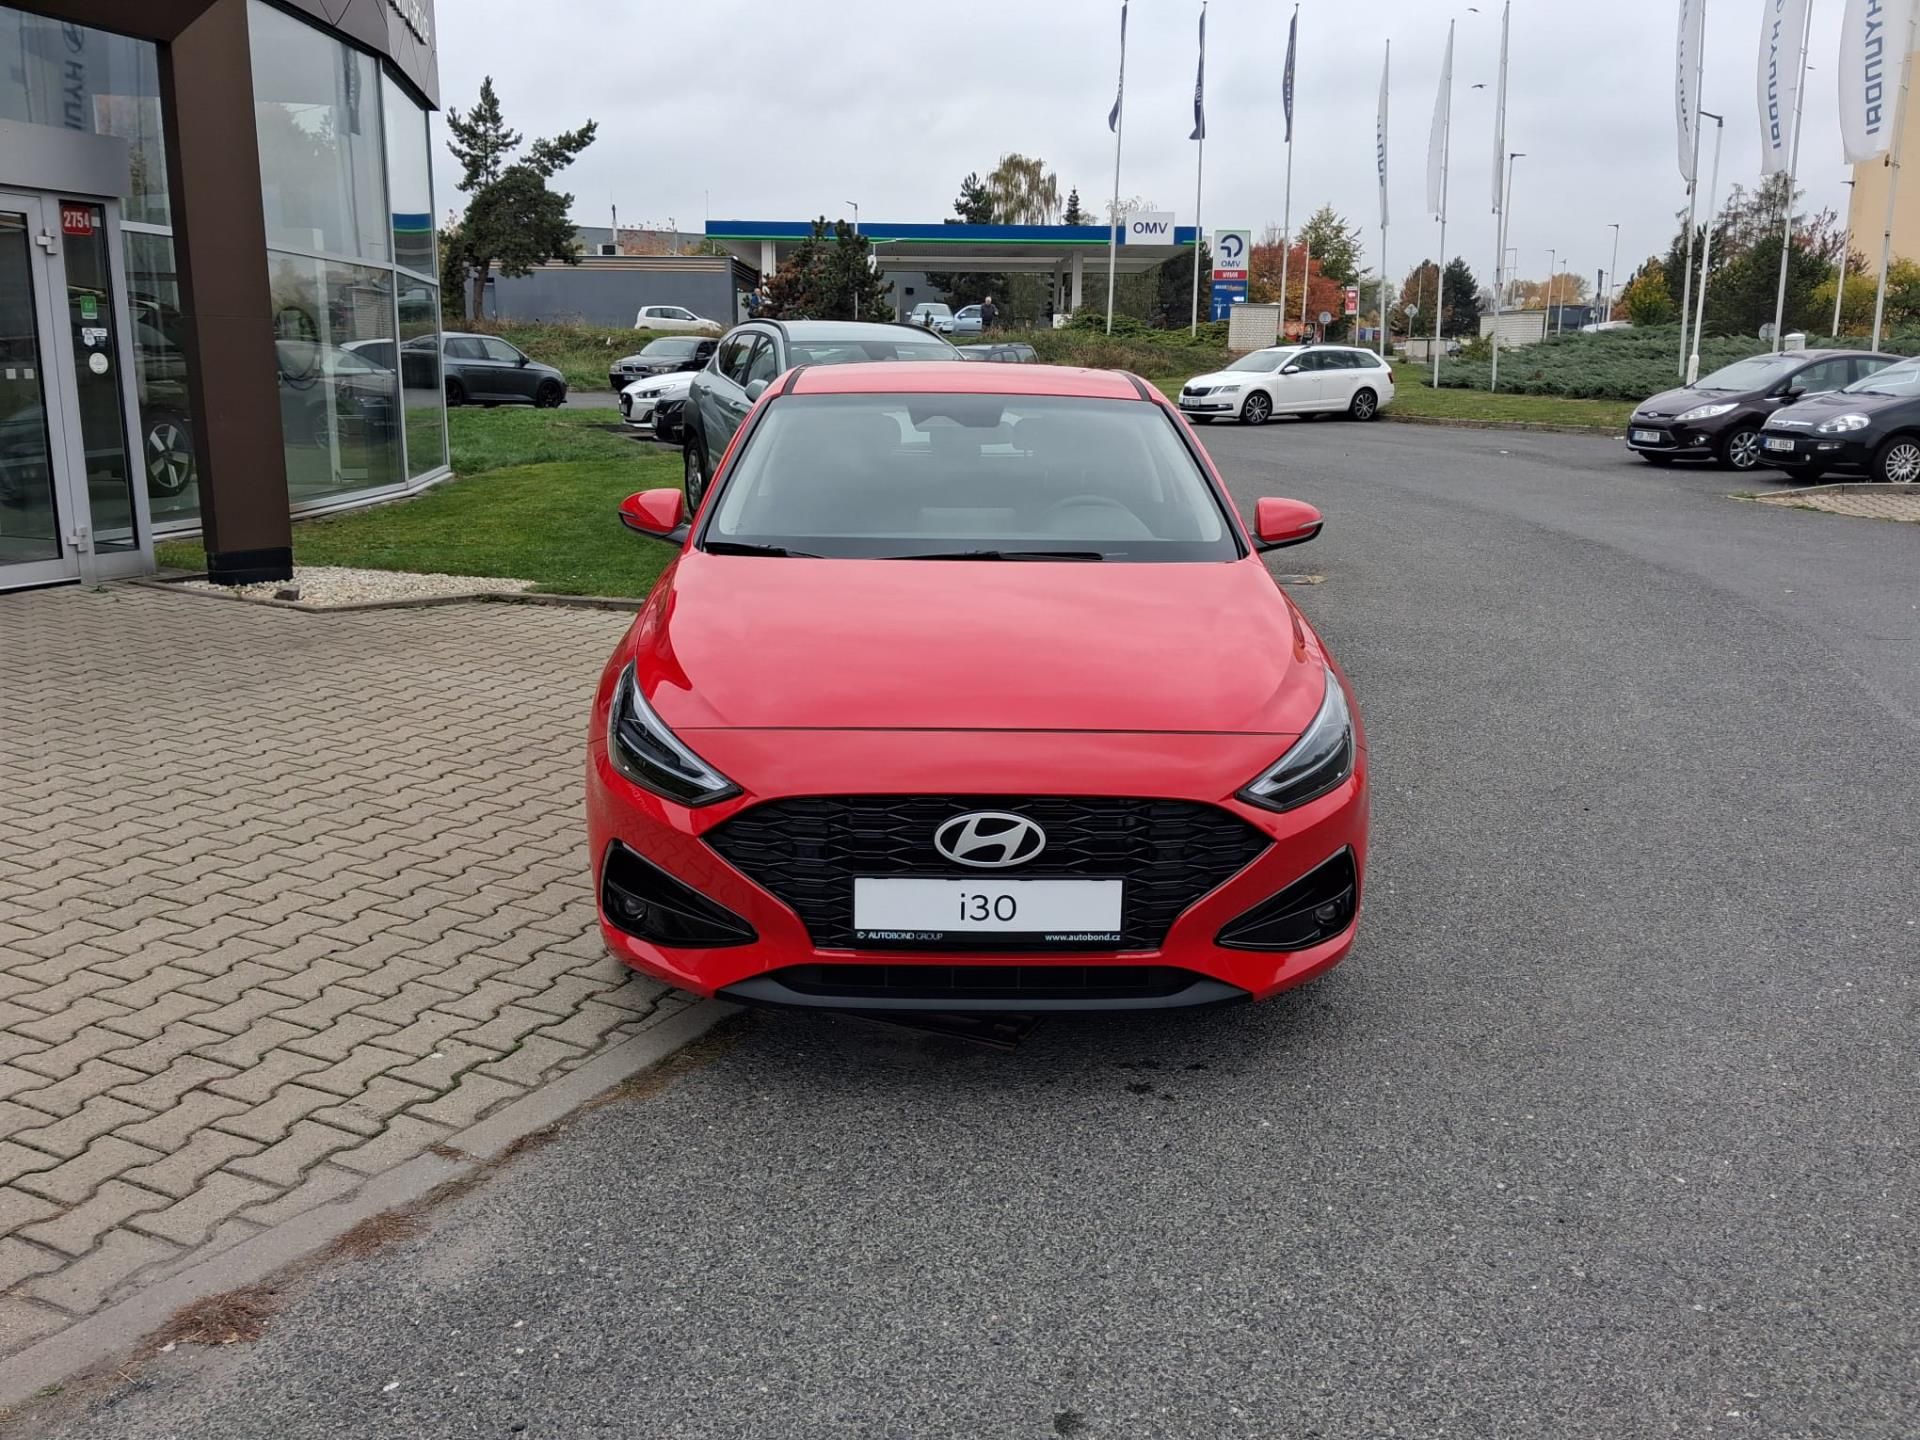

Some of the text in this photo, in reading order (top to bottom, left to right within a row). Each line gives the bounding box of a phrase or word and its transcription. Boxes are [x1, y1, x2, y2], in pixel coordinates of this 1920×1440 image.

[63, 211, 90, 228] 2754
[1133, 221, 1169, 234] OMV
[1221, 260, 1241, 268] OMV
[960, 893, 1017, 922] i30
[868, 931, 943, 941] AUTOBOND GROUP
[1044, 932, 1121, 941] www.autobond.cz
